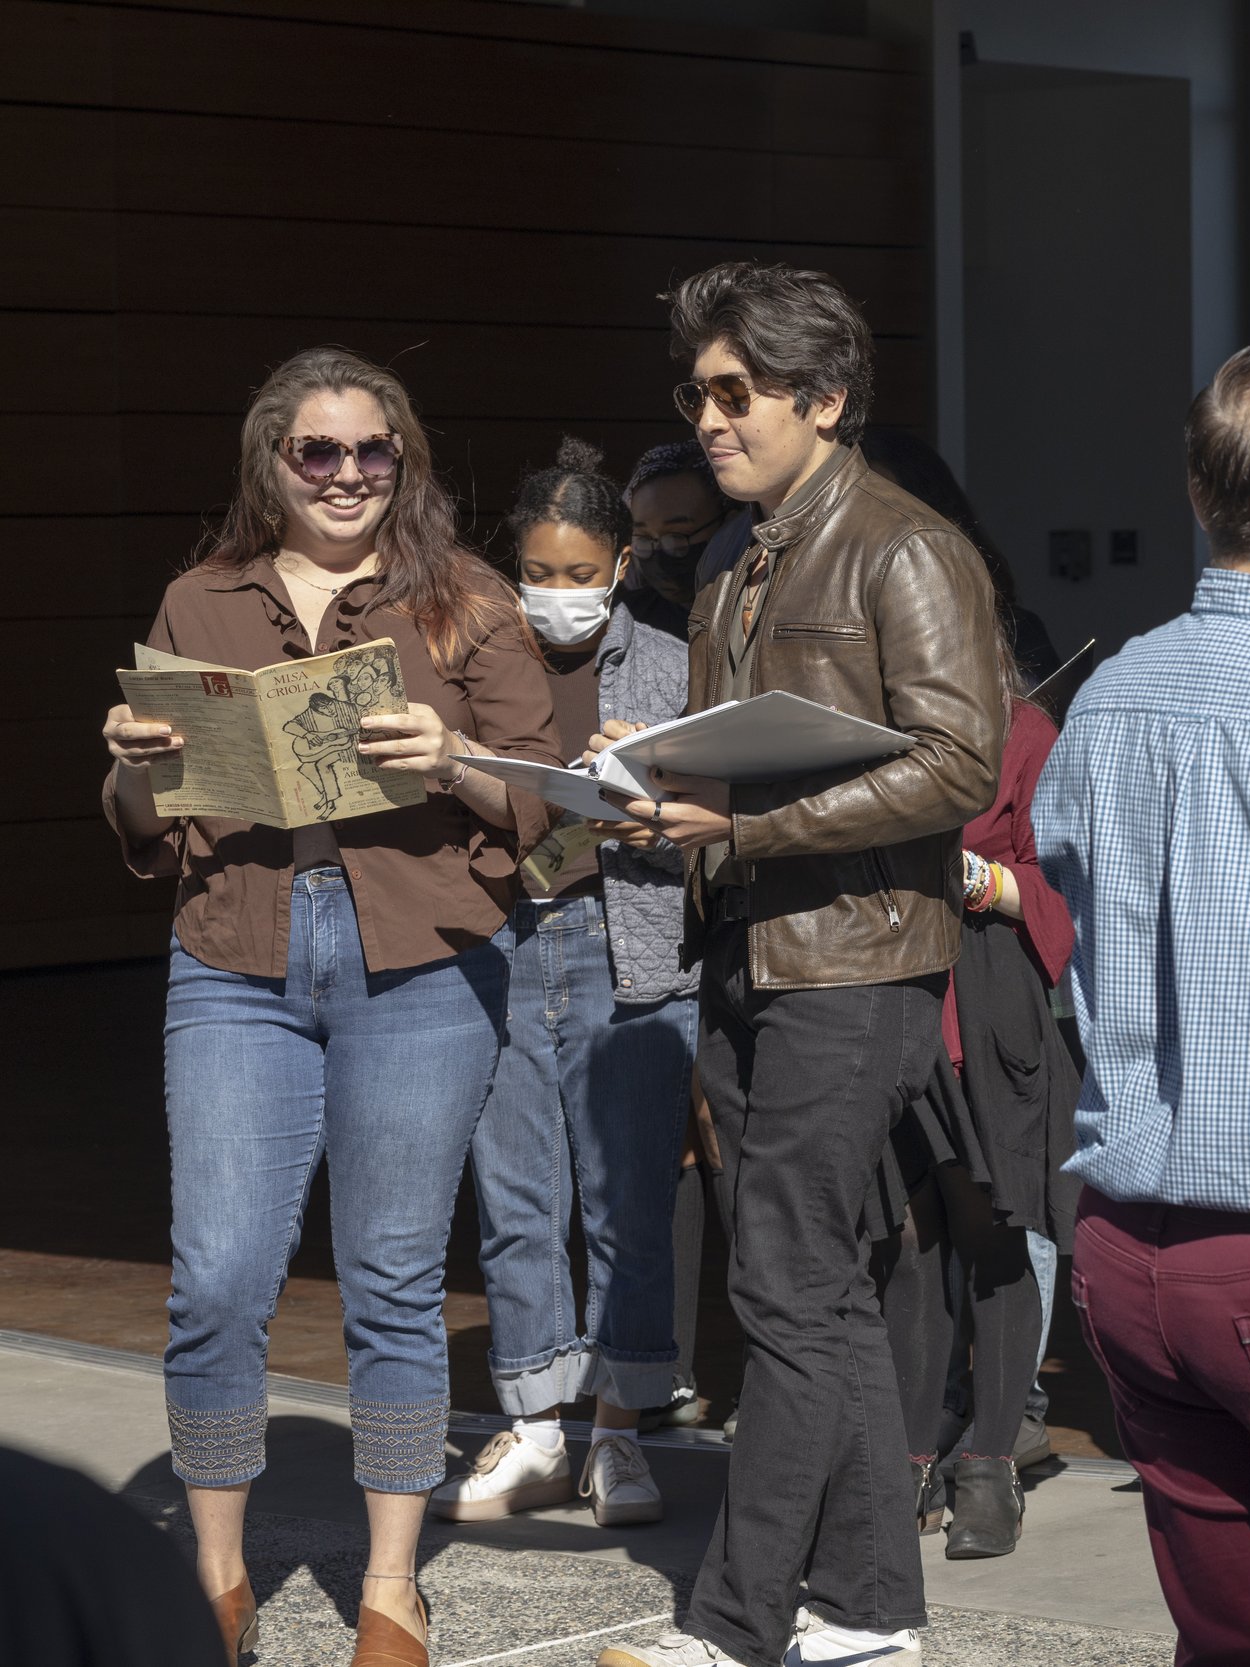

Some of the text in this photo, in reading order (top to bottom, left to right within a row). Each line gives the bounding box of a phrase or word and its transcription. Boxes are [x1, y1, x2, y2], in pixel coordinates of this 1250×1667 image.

[274, 671, 309, 685] MISA
[266, 681, 320, 698] CRIOLLA
[344, 768, 369, 778] ARIEL
